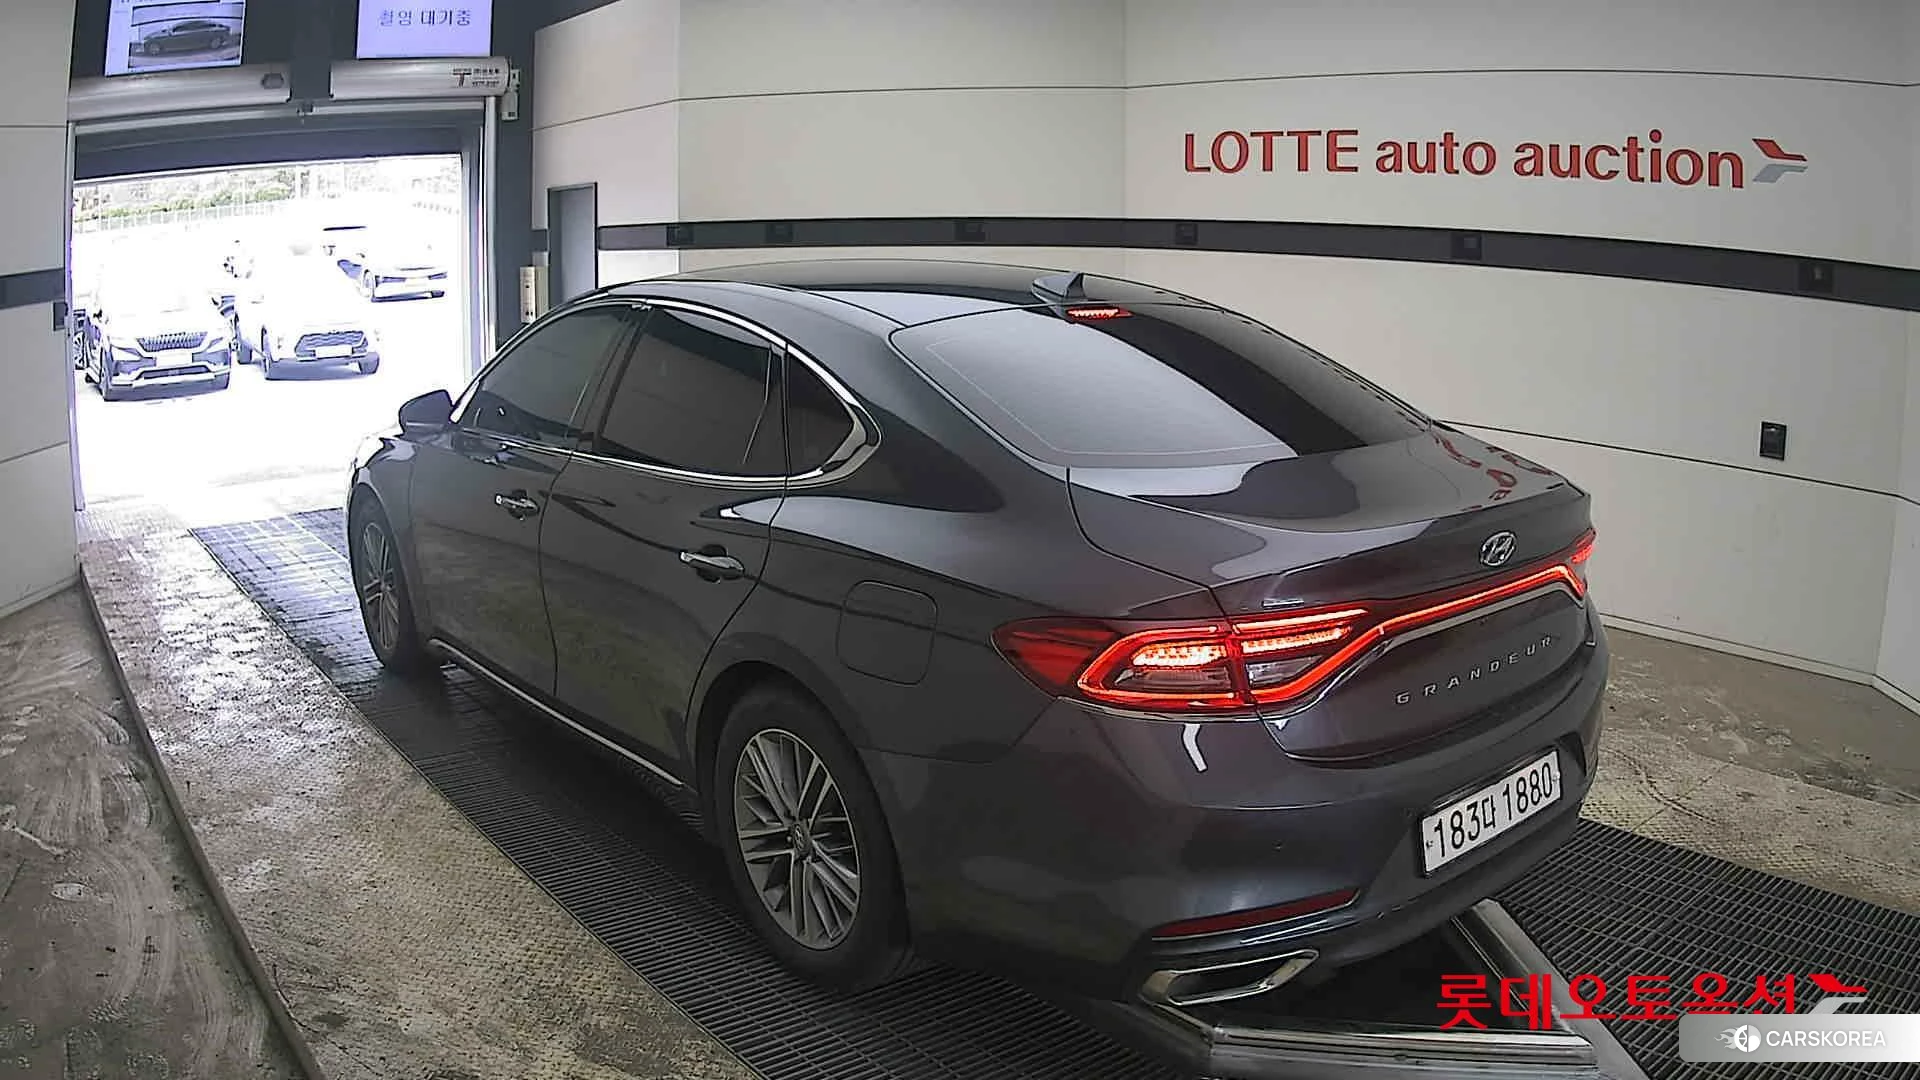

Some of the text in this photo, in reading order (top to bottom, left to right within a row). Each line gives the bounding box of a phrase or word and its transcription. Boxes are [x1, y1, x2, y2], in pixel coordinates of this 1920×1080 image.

[421, 9, 471, 26] 대기중
[1184, 128, 1744, 189] LOTTE auto auction
[1396, 636, 1551, 705] GRANDEUR
[1434, 762, 1553, 858] 183다 1880
